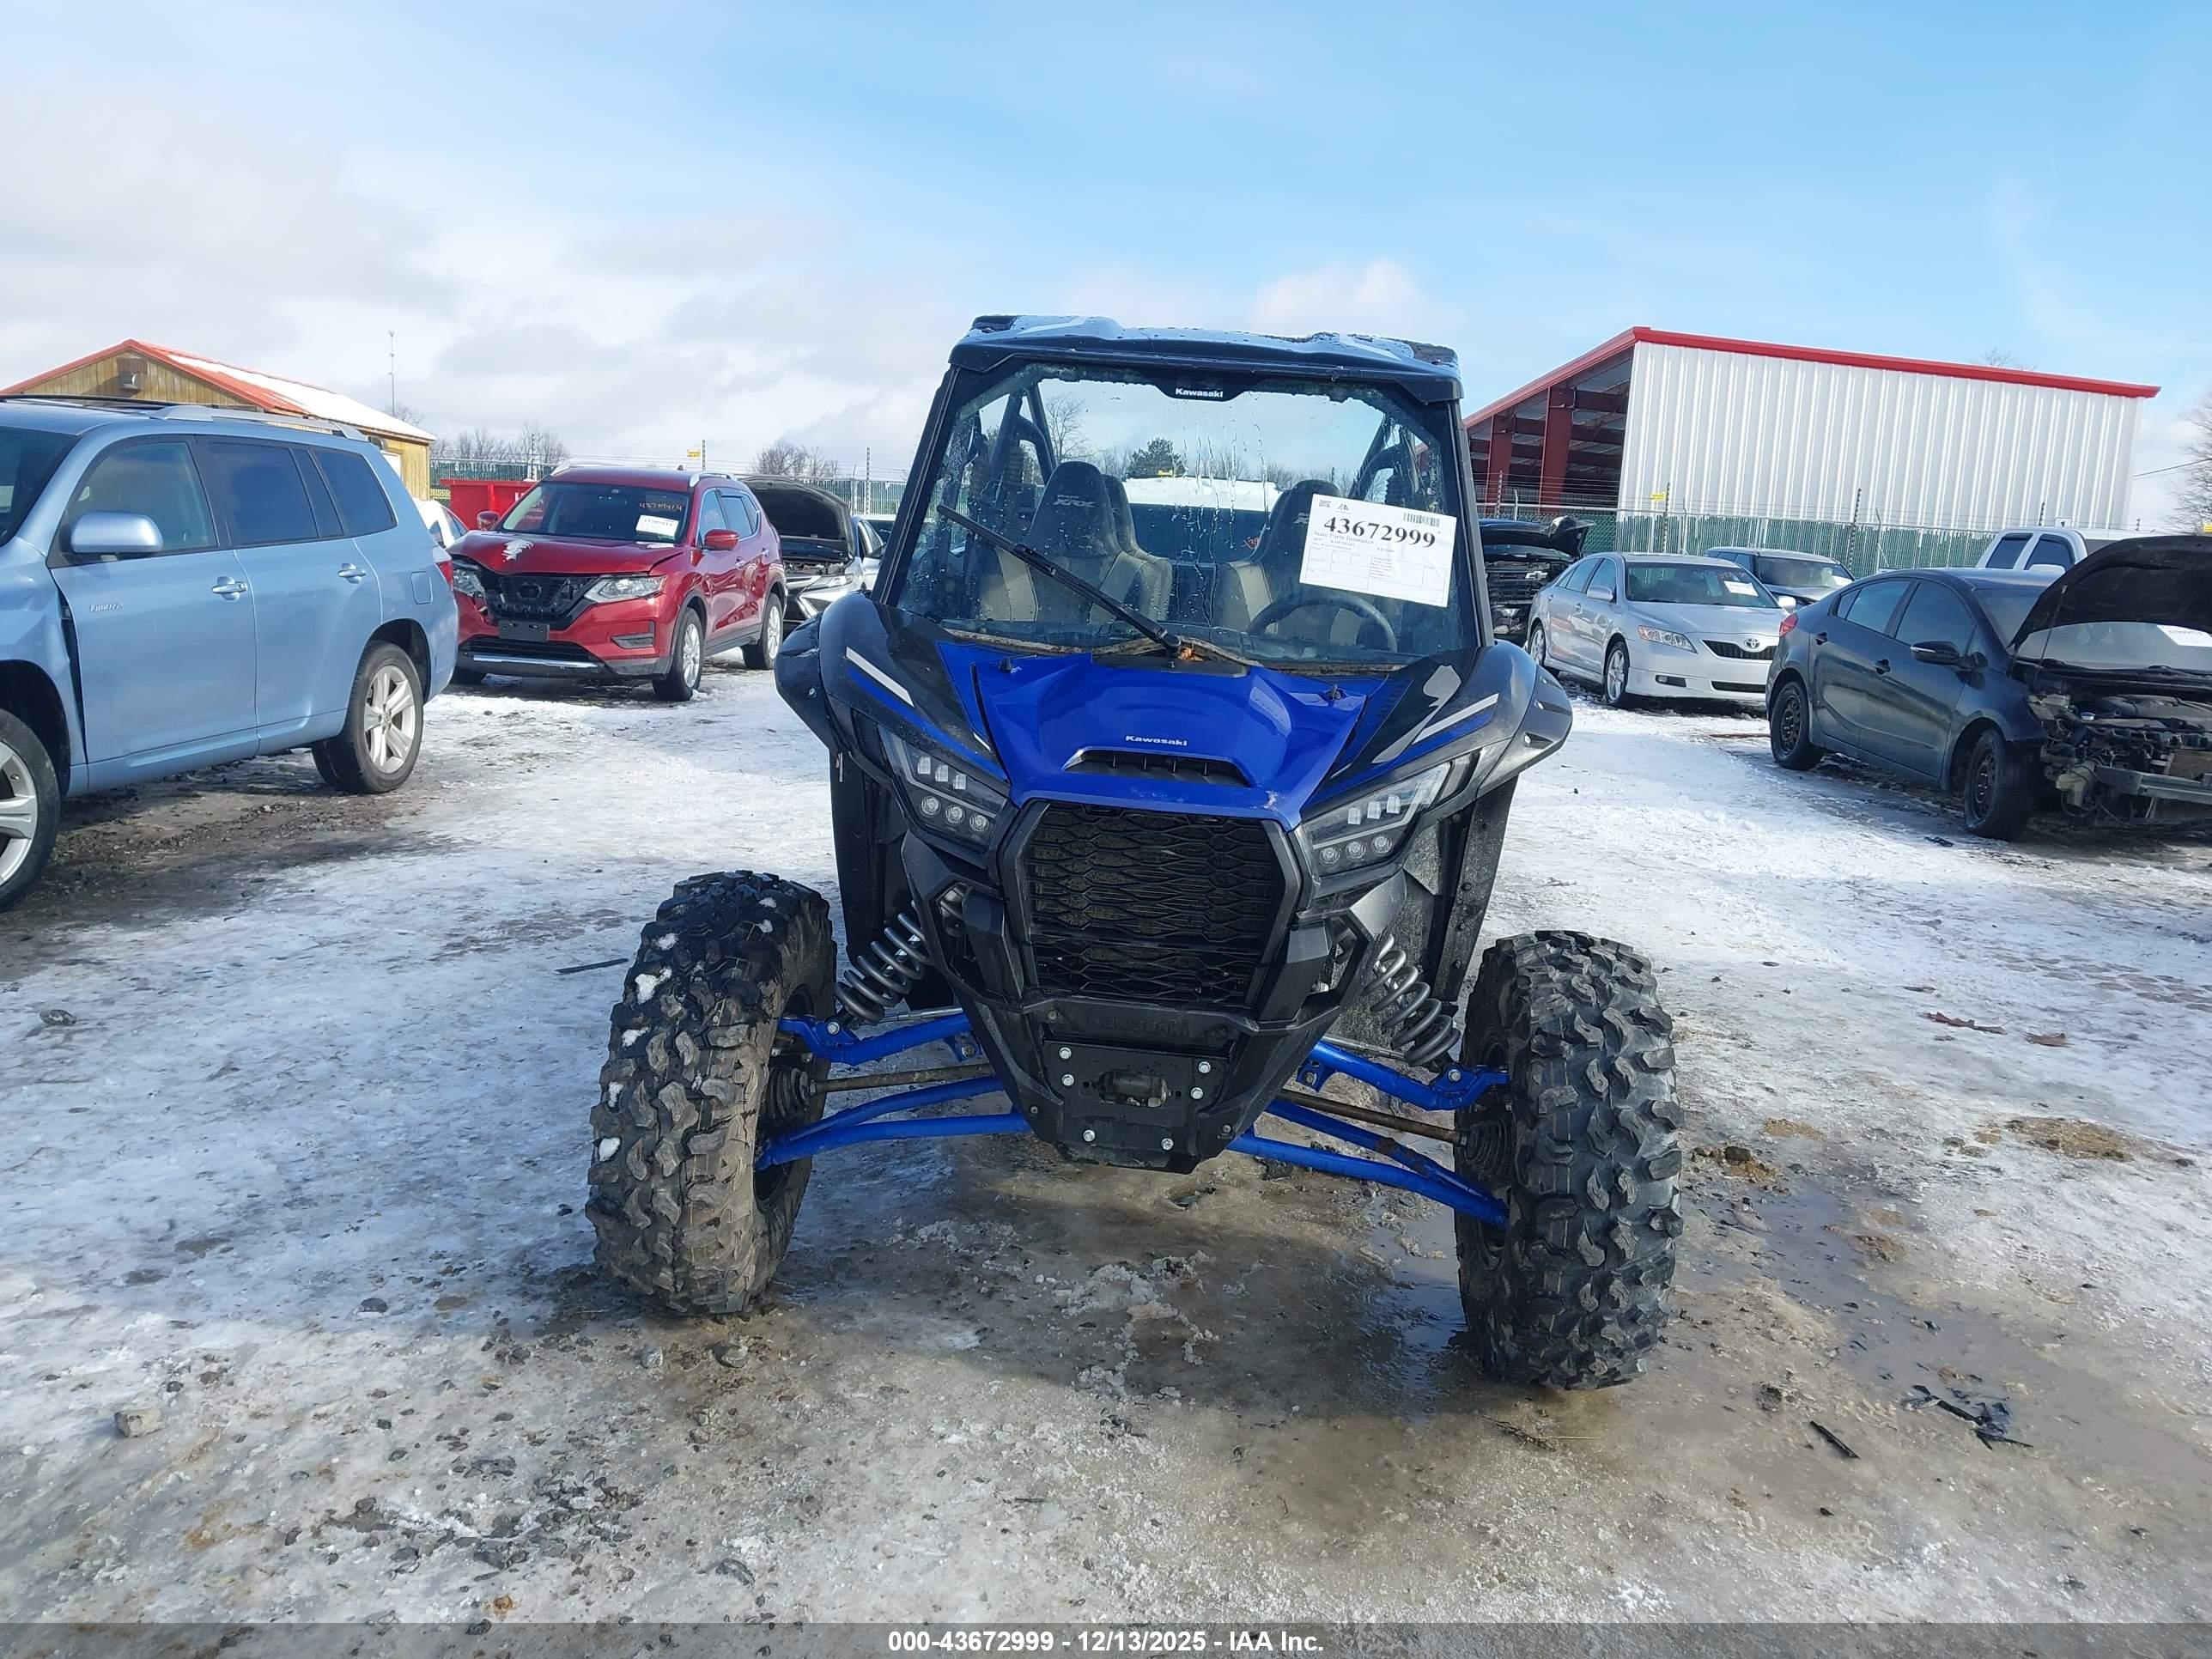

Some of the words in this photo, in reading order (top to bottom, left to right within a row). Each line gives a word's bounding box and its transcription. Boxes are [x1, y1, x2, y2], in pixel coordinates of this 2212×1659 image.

[1175, 387, 1224, 398] Kawasaki
[1323, 516, 1436, 548] 43672999
[1125, 735, 1188, 746] Kawasaki
